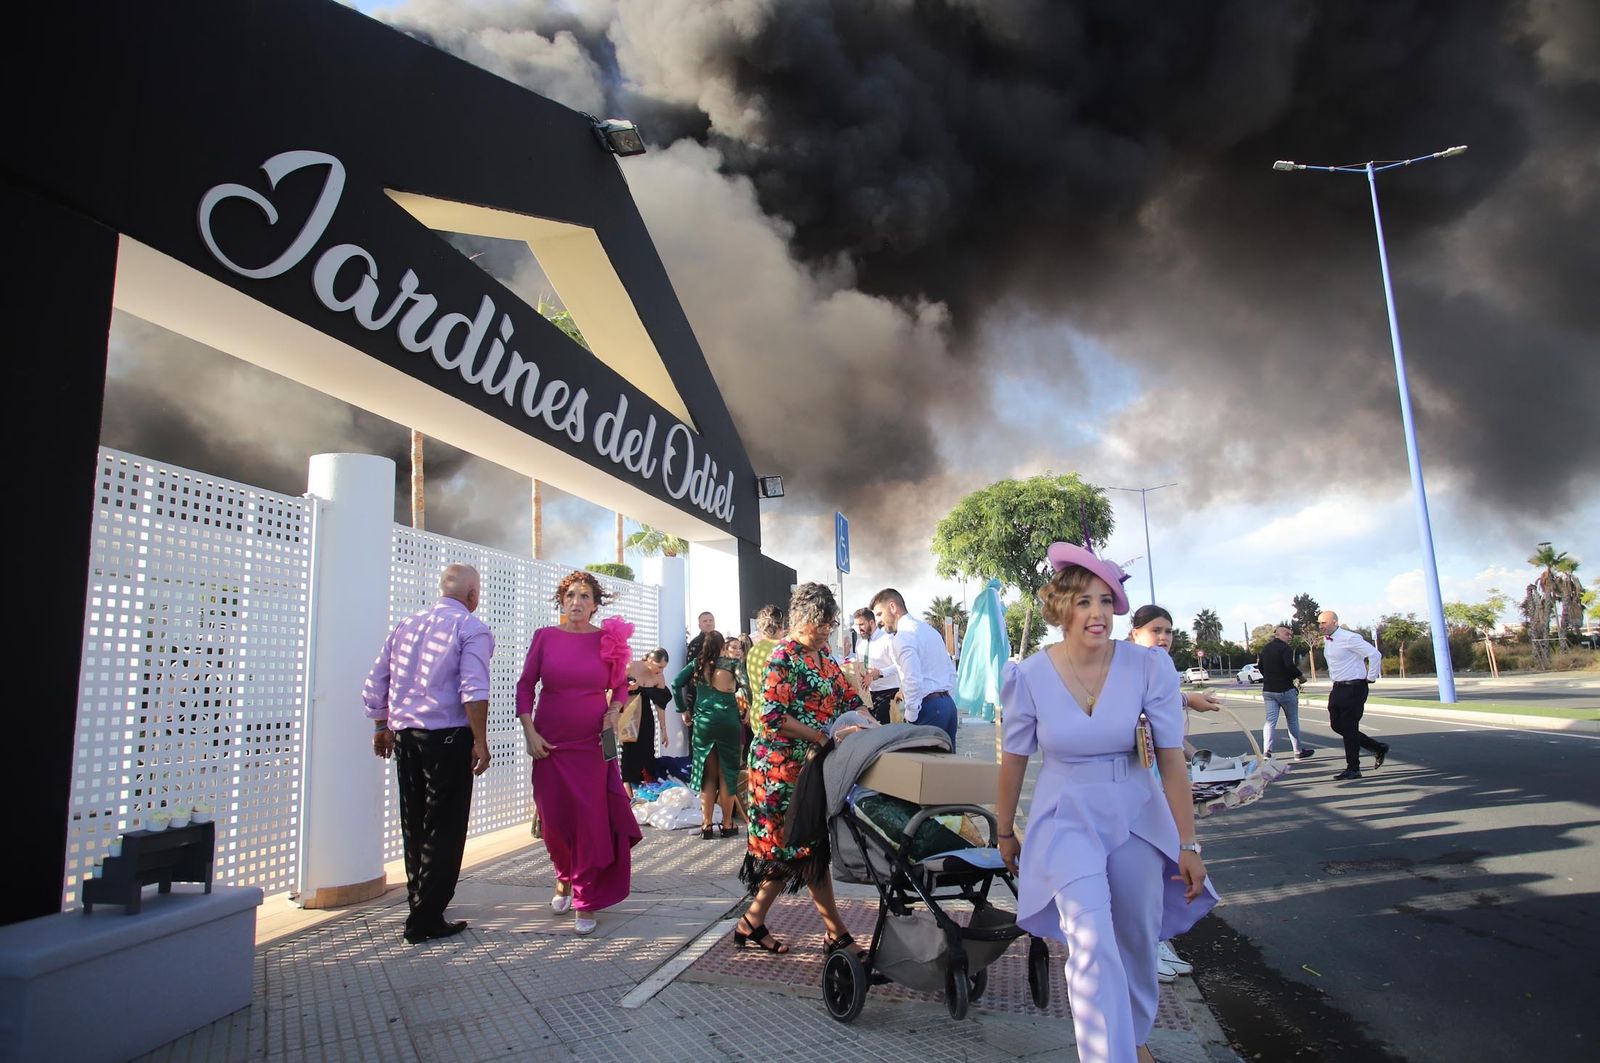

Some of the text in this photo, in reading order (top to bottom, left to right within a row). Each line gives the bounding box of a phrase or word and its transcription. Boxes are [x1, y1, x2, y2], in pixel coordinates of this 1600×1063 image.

[197, 150, 735, 523] Jardines del Odiel
